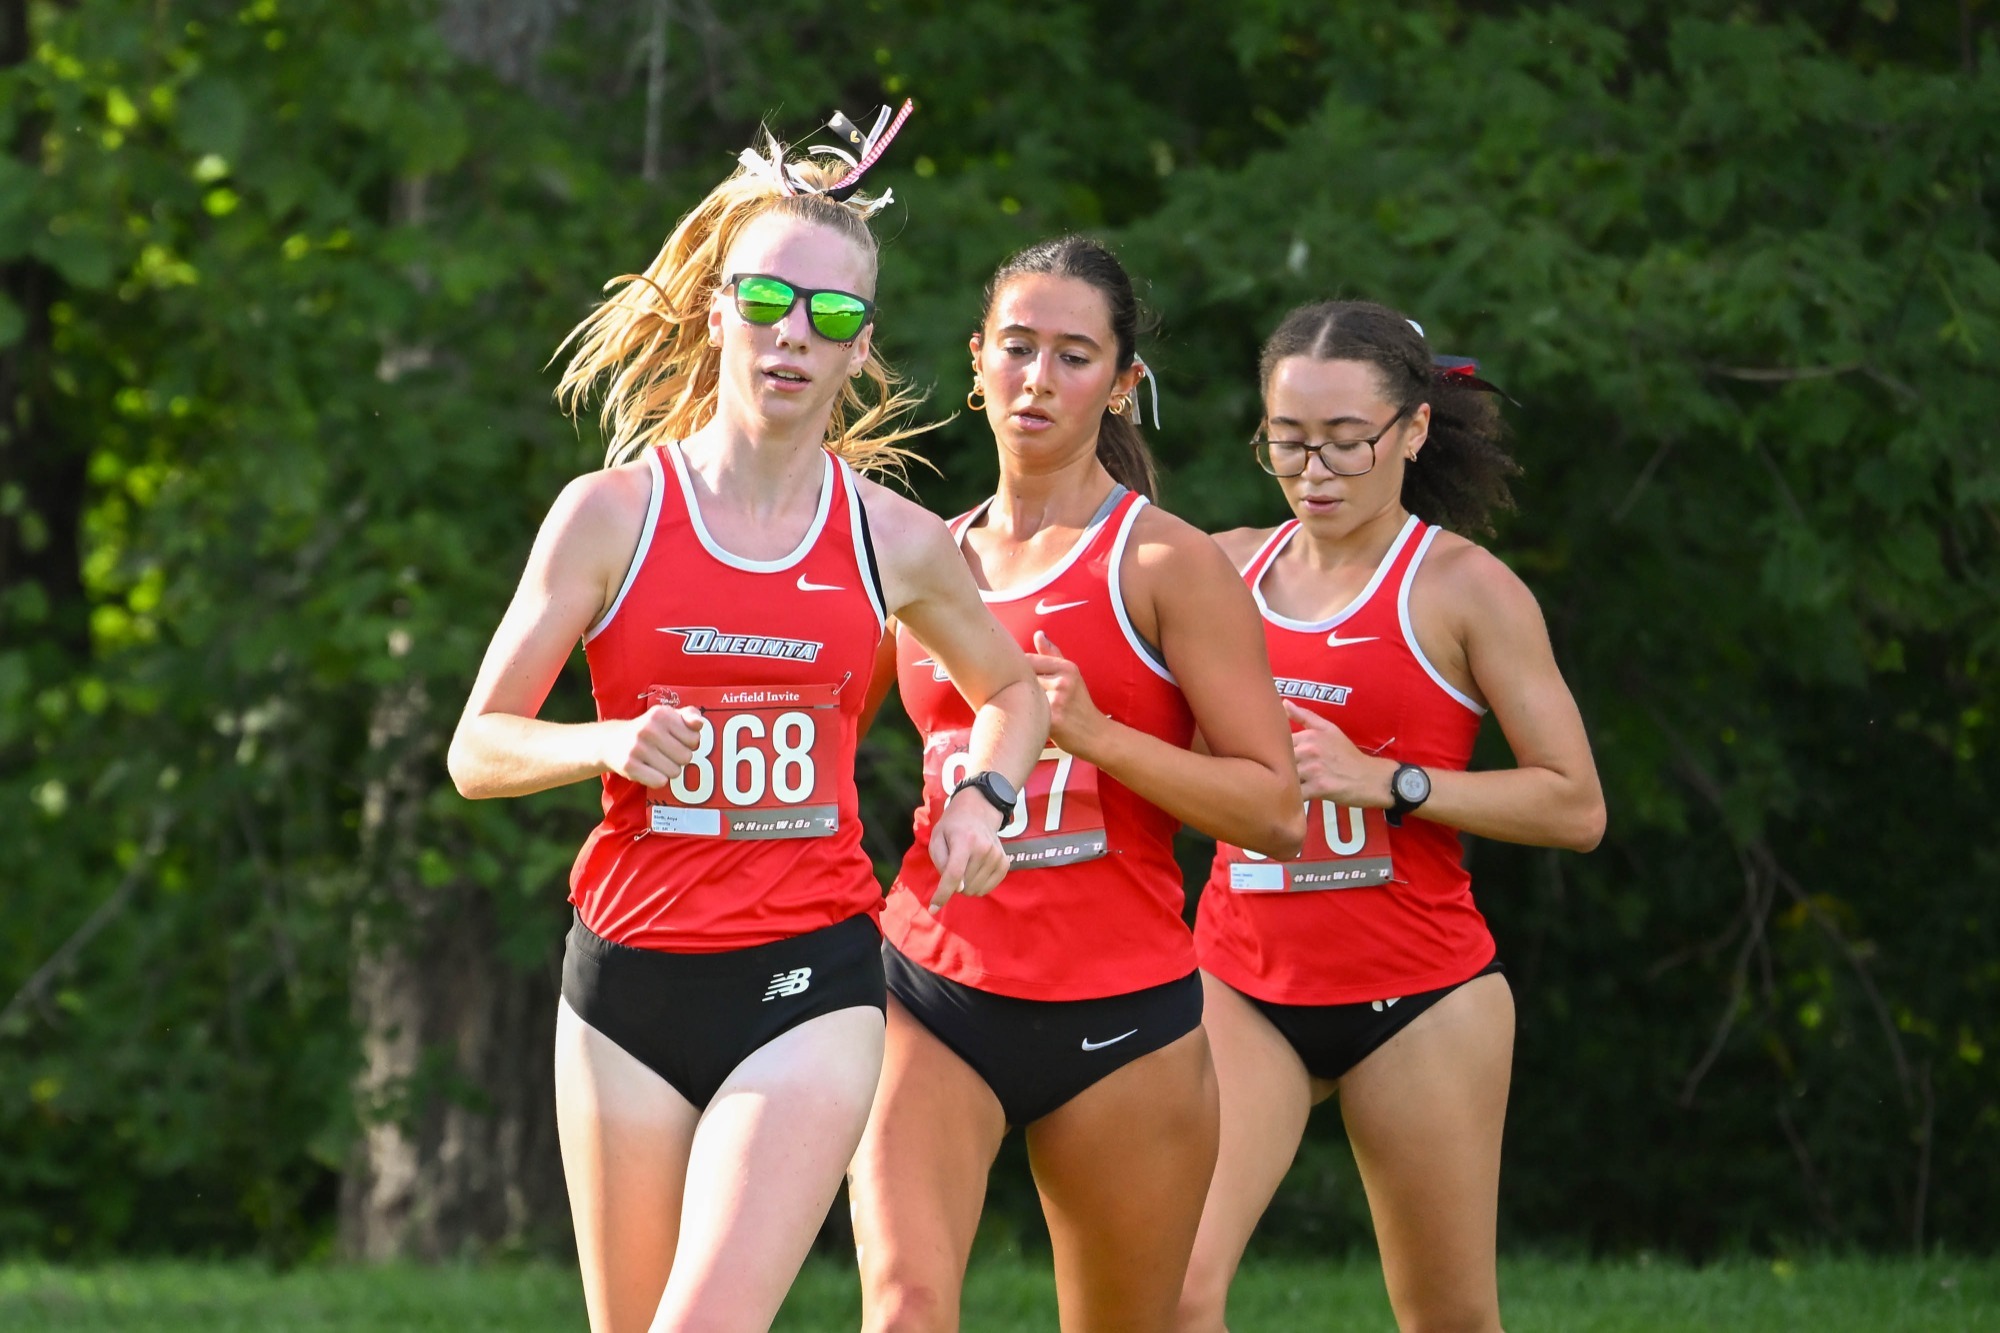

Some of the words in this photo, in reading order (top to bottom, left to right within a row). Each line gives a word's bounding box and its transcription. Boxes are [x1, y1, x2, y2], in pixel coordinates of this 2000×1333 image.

[682, 626, 822, 663] ONEONTA
[720, 692, 764, 703] Airfield
[766, 691, 800, 702] Invite
[1273, 677, 1348, 706] EONTA
